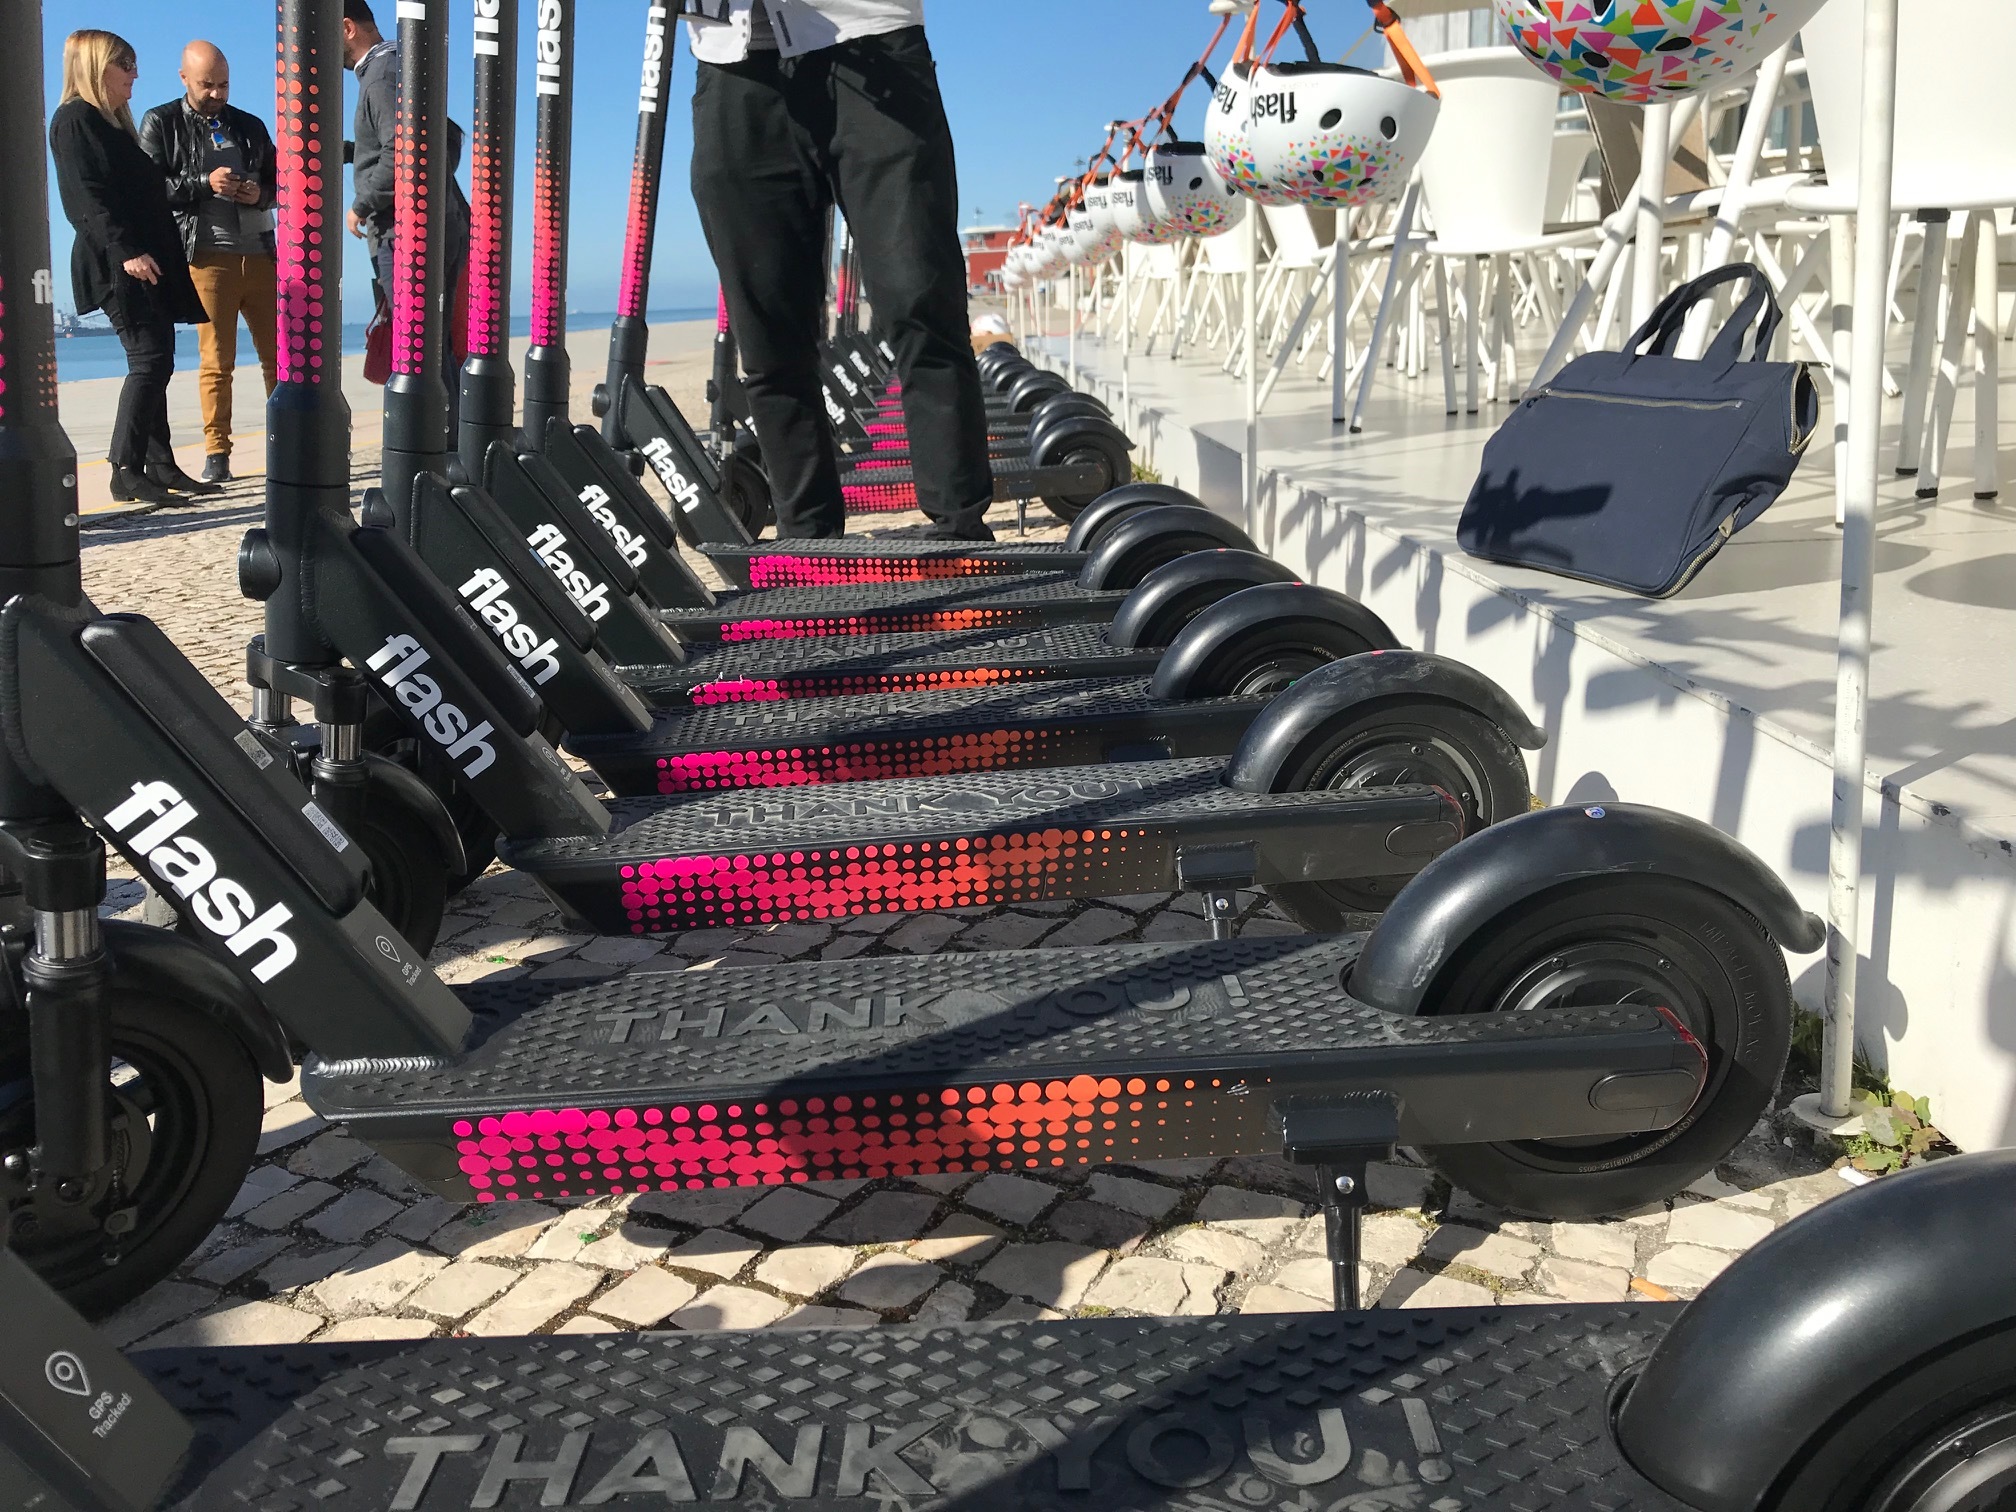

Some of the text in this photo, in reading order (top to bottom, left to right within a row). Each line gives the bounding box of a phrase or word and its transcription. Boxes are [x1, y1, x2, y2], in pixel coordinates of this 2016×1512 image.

[642, 437, 700, 514] flash
[577, 484, 650, 568] flash
[526, 523, 610, 622] flash
[457, 567, 560, 685] flash
[366, 634, 497, 780] flash
[702, 793, 949, 827] THANK
[103, 780, 298, 984] flash
[595, 974, 1251, 1044] THANK YOU!
[89, 1391, 114, 1419] GPS
[92, 1392, 132, 1438] Tracked
[383, 1397, 1455, 1512] THANK YOU!
